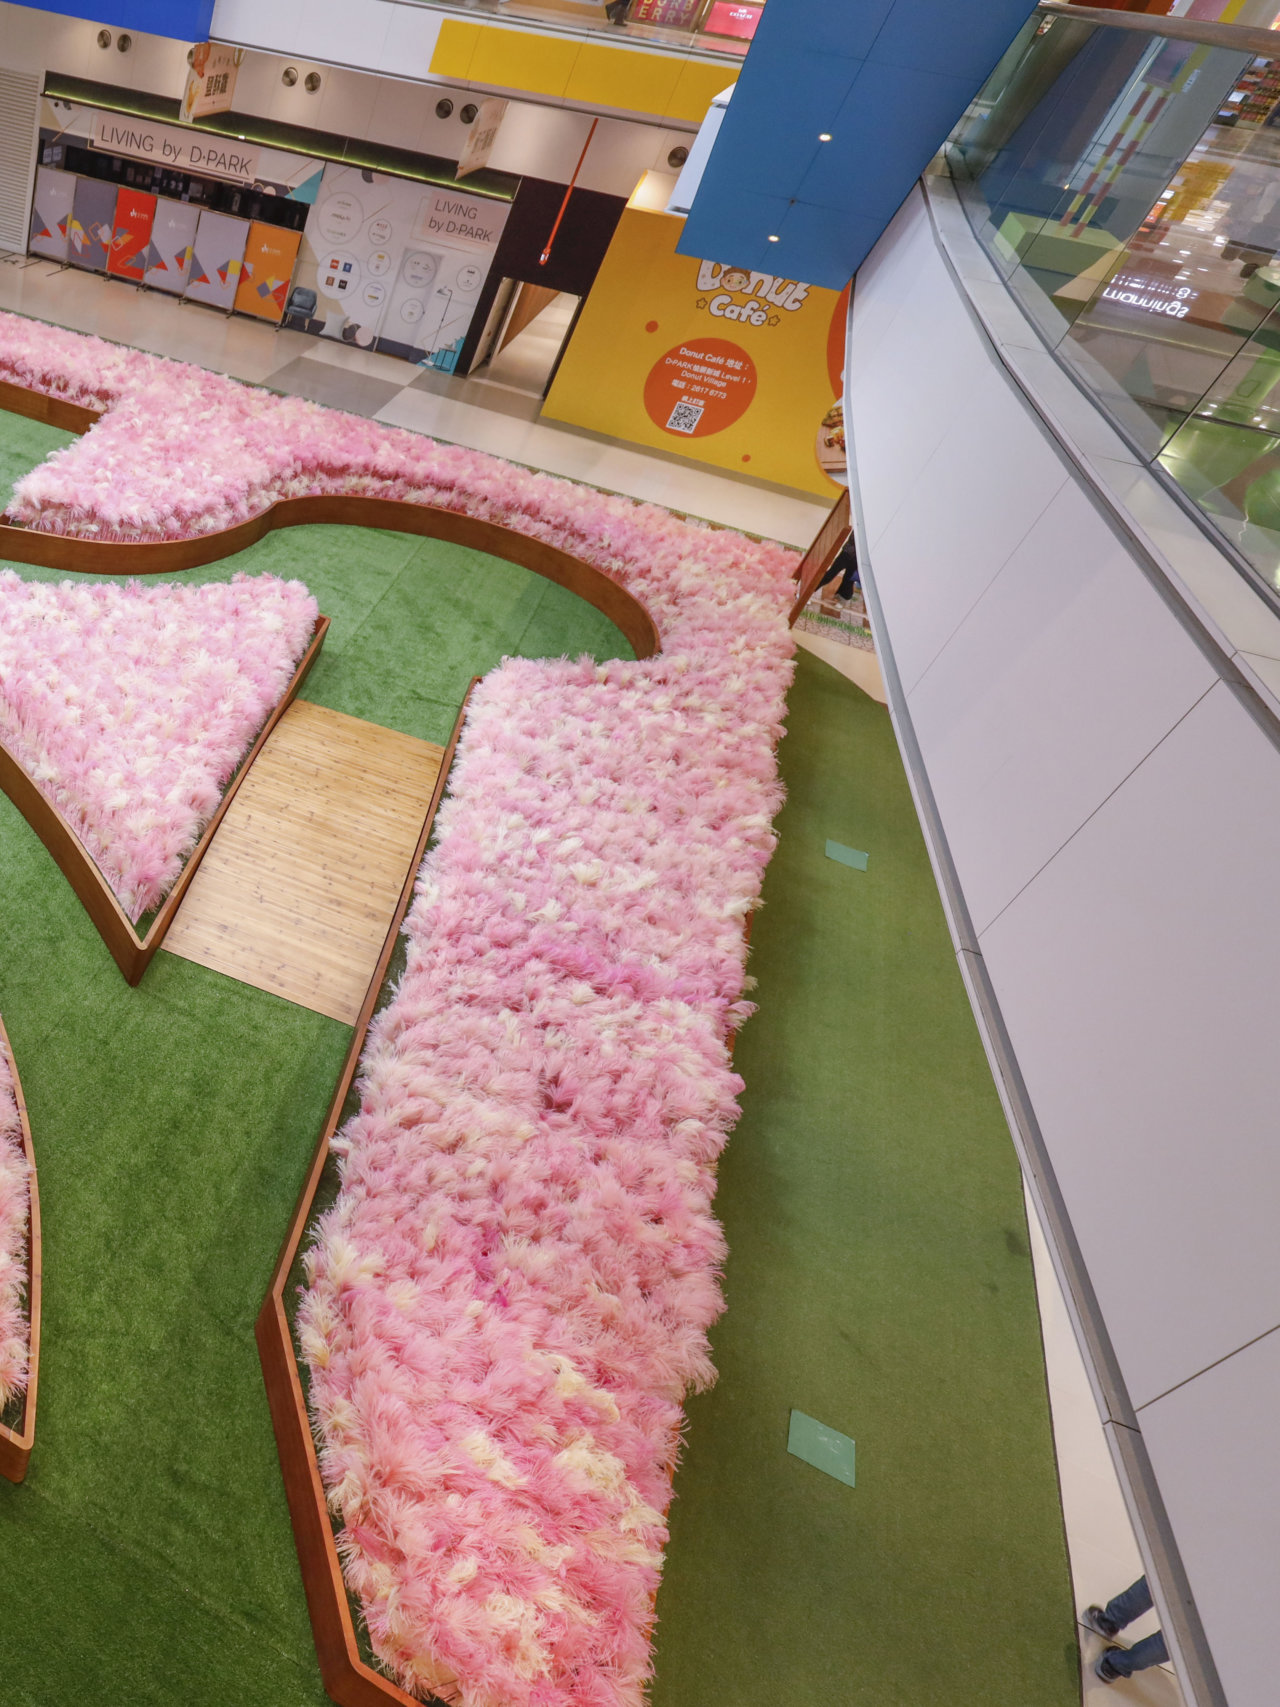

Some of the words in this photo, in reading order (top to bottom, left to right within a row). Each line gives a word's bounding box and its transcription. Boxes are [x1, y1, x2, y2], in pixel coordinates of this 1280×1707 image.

[639, 6, 690, 25] ERRY
[101, 124, 154, 153] LIVING
[162, 138, 182, 162] by
[434, 199, 478, 220] LIVING
[428, 216, 445, 233] by
[709, 294, 771, 326] Café
[679, 347, 705, 360] Donut
[705, 353, 725, 365] Café
[681, 370, 703, 381] Donut
[703, 376, 727, 388] Village
[721, 372, 741, 382] Level
